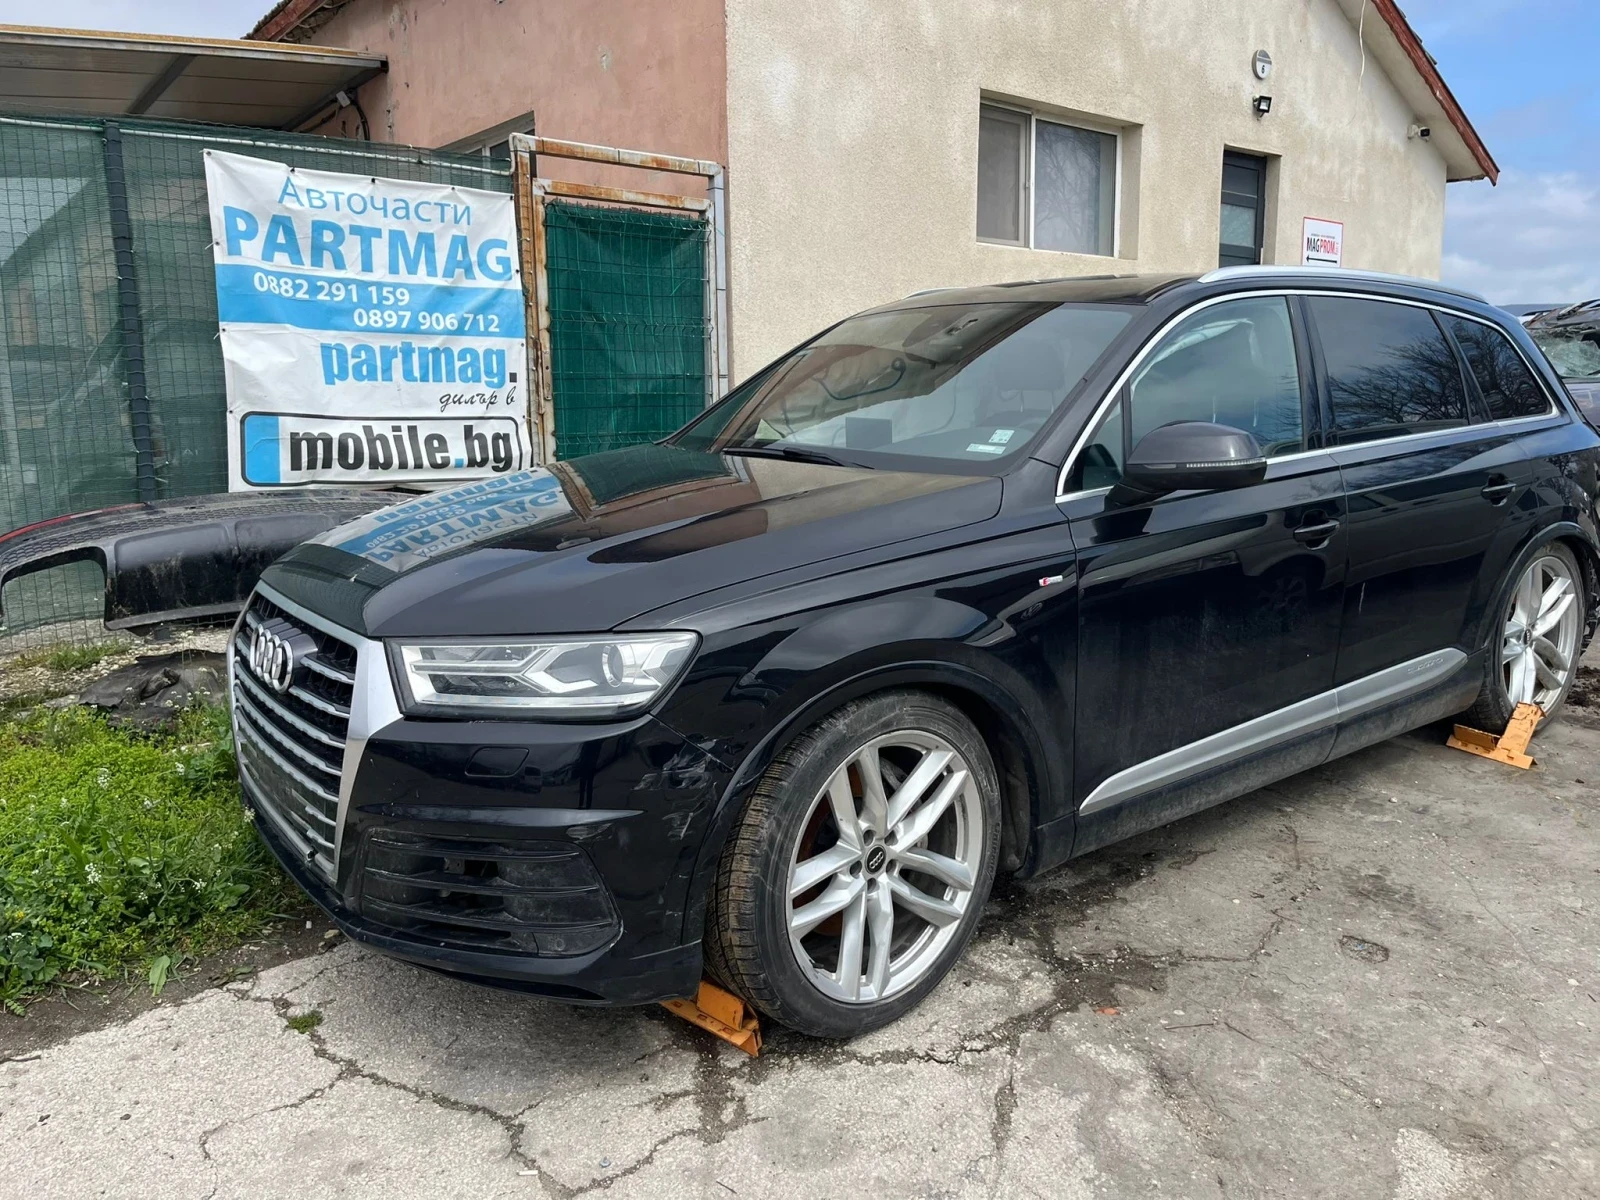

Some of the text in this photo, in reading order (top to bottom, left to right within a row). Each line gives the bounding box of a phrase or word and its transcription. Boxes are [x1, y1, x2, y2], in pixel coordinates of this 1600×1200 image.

[1261, 64, 1265, 74] 6
[277, 176, 471, 226] Авточасти
[223, 205, 513, 282] PARTMAG
[253, 271, 410, 306] 0882 291 159
[353, 308, 500, 333] 0897 906 712
[439, 386, 516, 412] дилър в
[289, 424, 513, 473] mobile.bg
